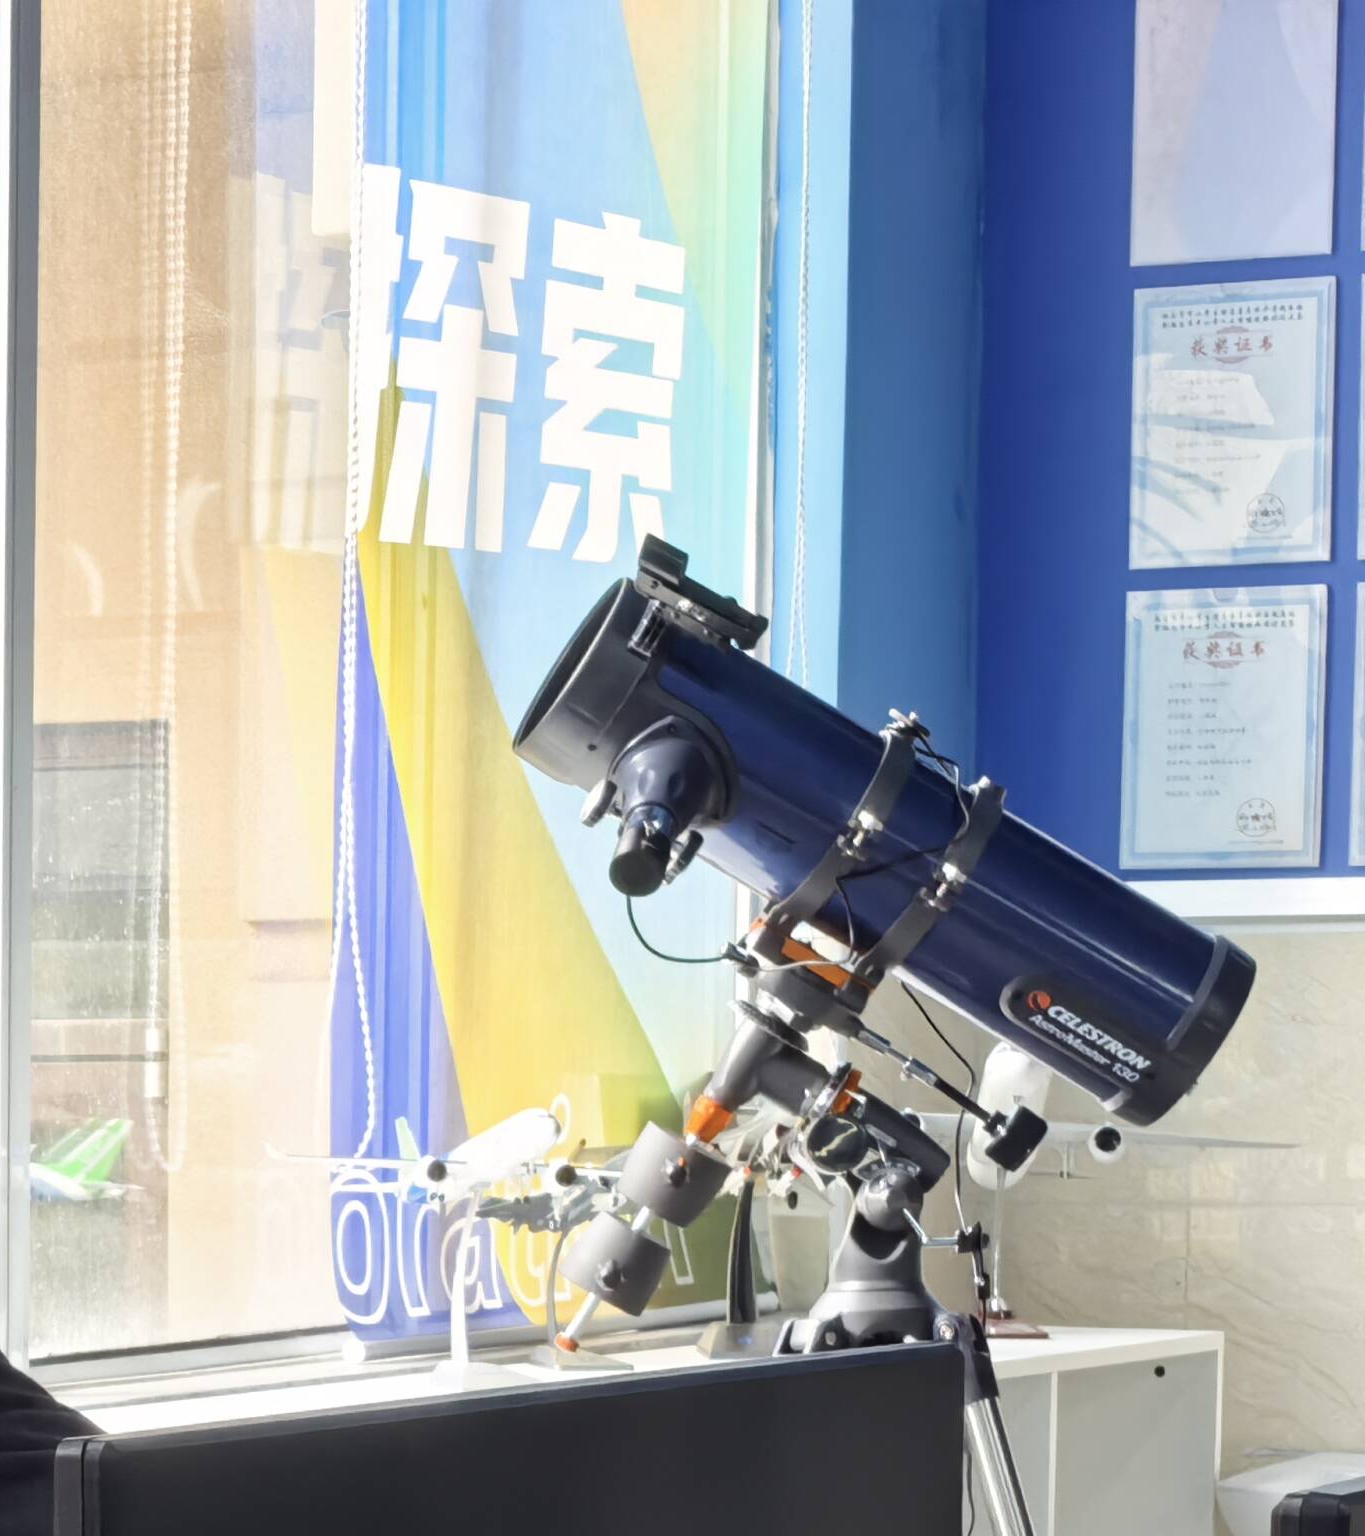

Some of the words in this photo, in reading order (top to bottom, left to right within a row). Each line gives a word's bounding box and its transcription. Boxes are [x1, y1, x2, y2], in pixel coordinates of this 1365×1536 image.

[346, 162, 686, 563] 探索
[1190, 335, 1274, 359] 获奖证书
[1027, 1012, 1111, 1066] AstroMaster
[1110, 1058, 1141, 1083] 130
[1047, 1004, 1153, 1071] CELESTRON
